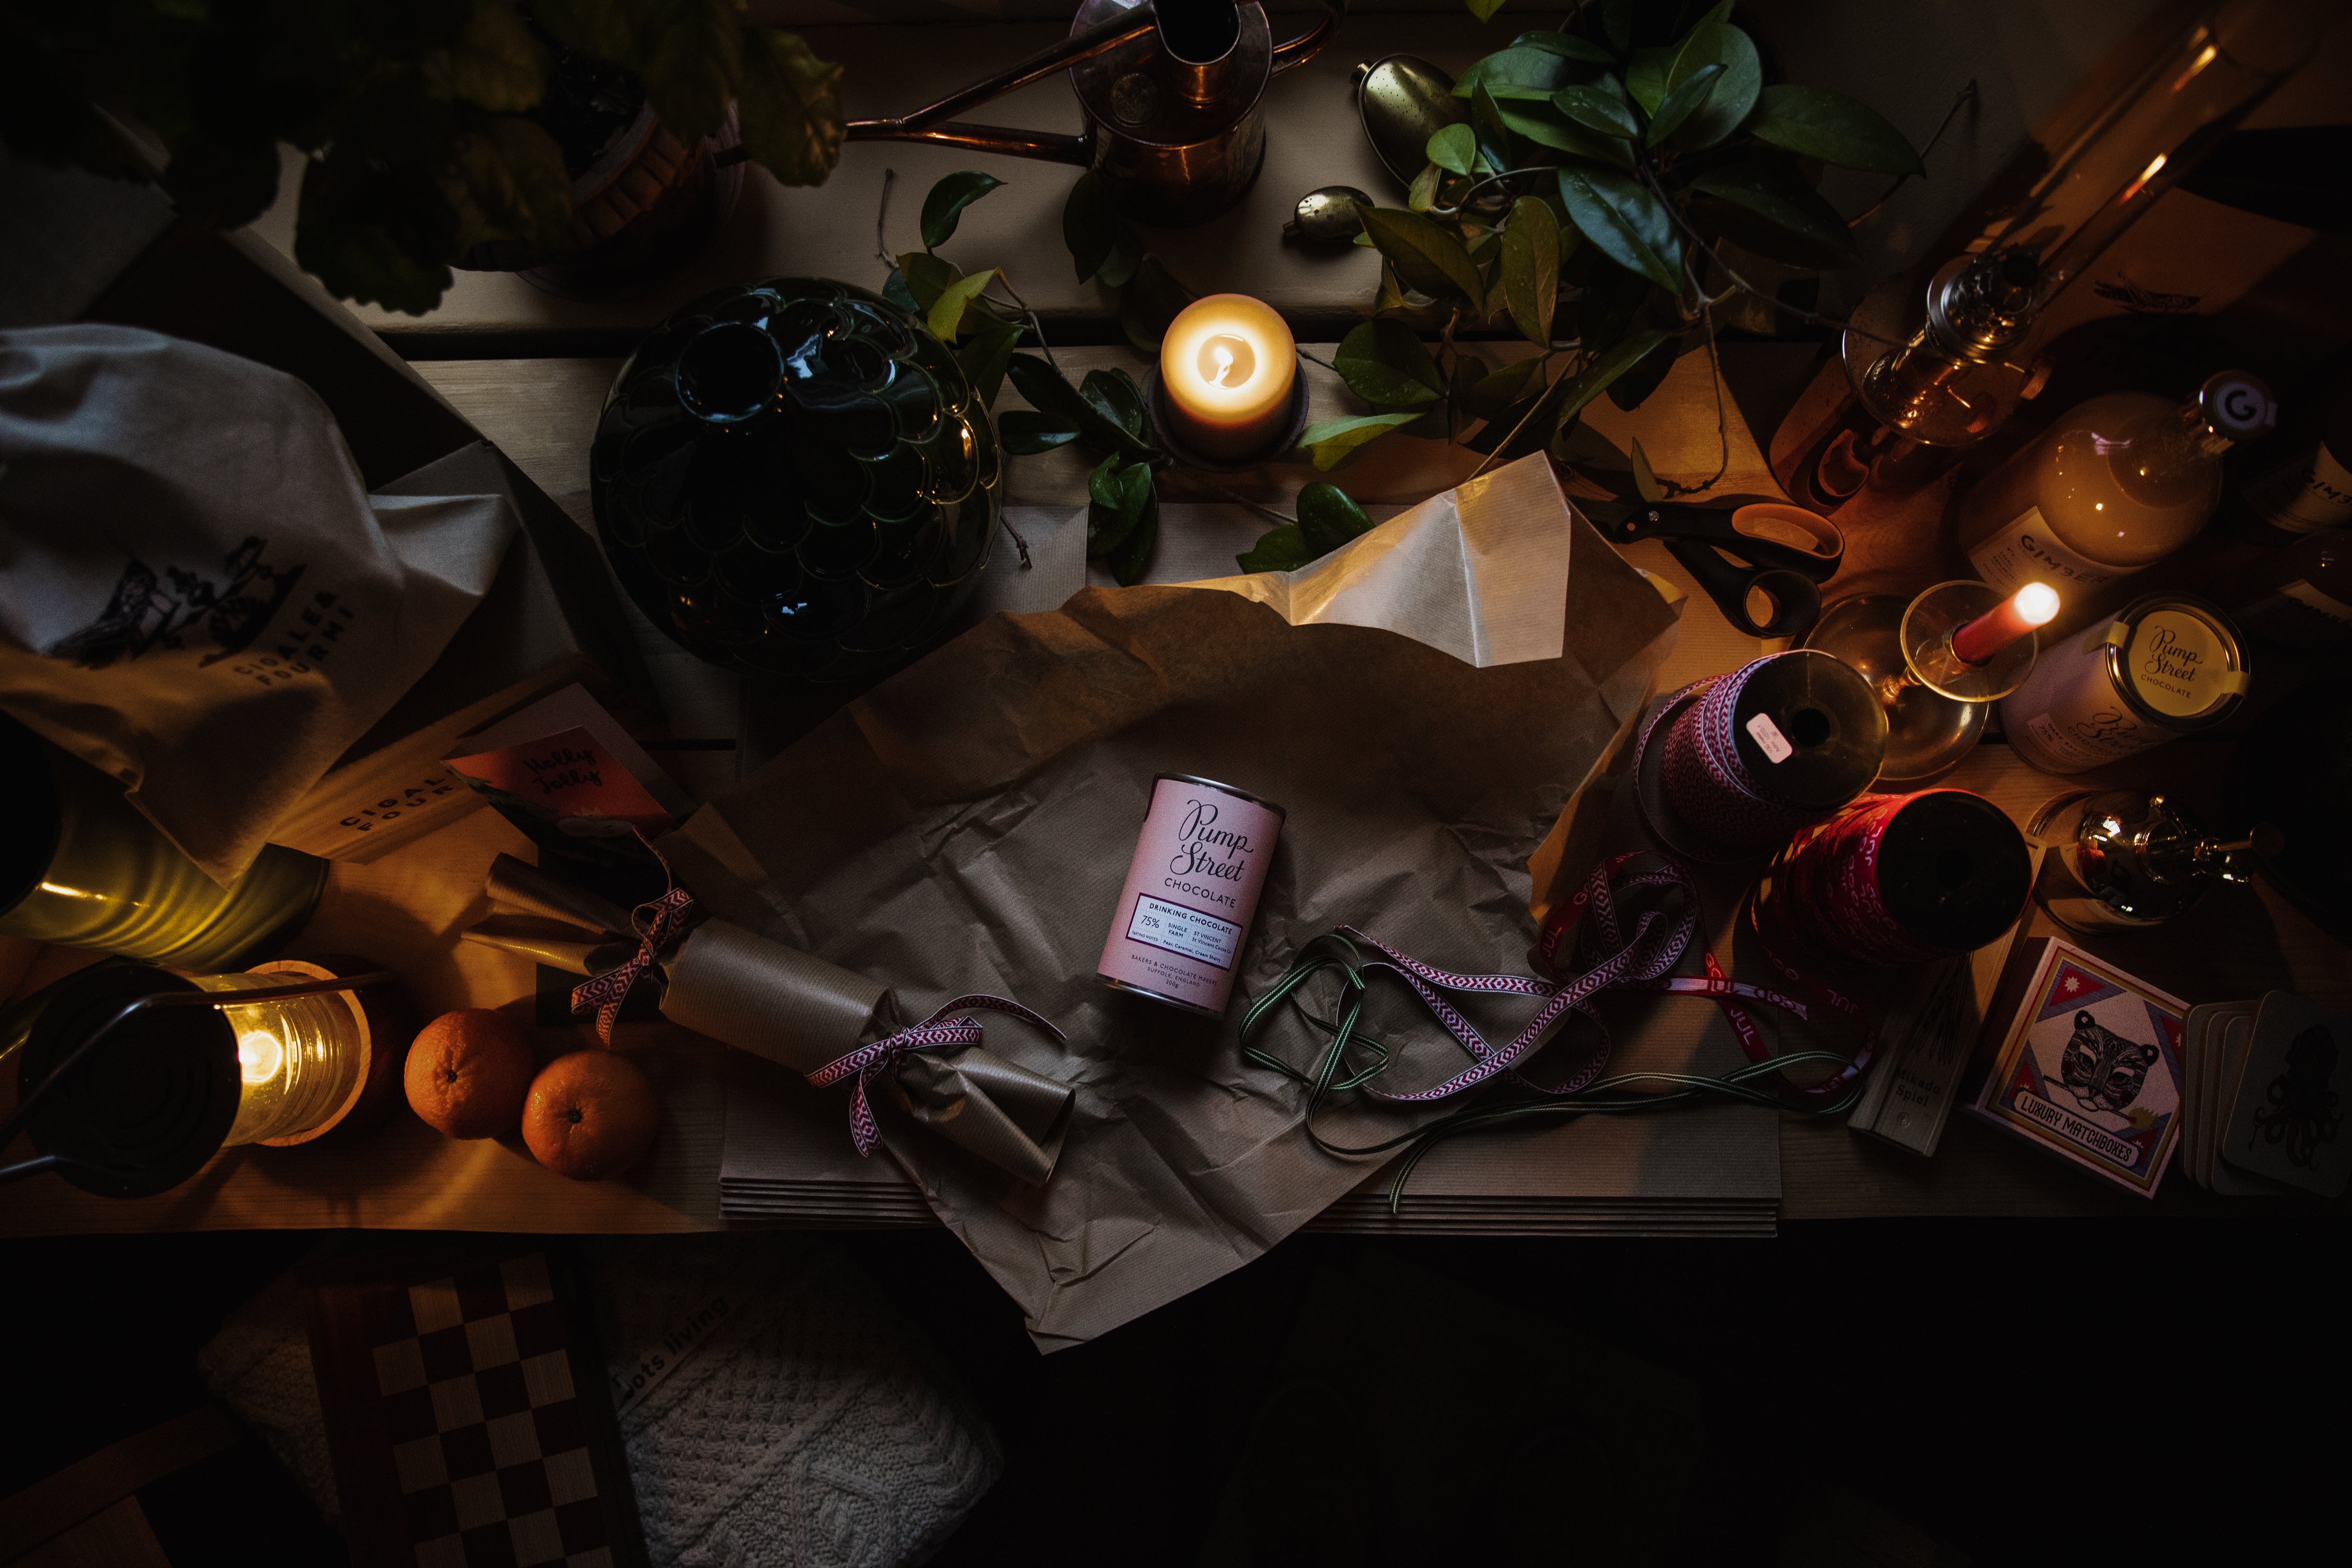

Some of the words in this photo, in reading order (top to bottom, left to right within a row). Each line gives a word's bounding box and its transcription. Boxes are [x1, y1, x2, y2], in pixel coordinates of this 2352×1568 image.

[2225, 390, 2257, 422] G
[256, 606, 354, 685] FOURMI
[2149, 625, 2203, 667] Pump
[2145, 653, 2196, 682] Street
[2140, 674, 2191, 699] CHOCOLATE
[523, 747, 596, 775] Holly
[532, 769, 603, 794] Jolly
[340, 769, 454, 826] CIGAL
[1179, 799, 1254, 859] Pump
[1864, 825, 1883, 867] JUL
[1170, 841, 1246, 882] Street
[1165, 878, 1237, 908] CHOCOLATE
[1140, 915, 1160, 929] 75%
[1149, 903, 1187, 919] DRINKING
[1189, 915, 1233, 935] CHOCOLATE
[1167, 923, 1188, 933] SINGLE
[1168, 929, 1184, 938] FARM
[1198, 939, 1215, 949] Vincent
[1201, 933, 1222, 944] VINCENT
[1542, 926, 1563, 959] JUL
[1131, 954, 1152, 965] BAKERS
[1160, 963, 1197, 979] CHOCOLATE
[1198, 975, 1217, 986] MAKERS
[1209, 954, 1221, 963] Sherry
[1166, 979, 1179, 989] 200g
[1174, 975, 1201, 988] ENGLAND
[1730, 1008, 1755, 1046] JUL
[1895, 1069, 1941, 1095] Mikado
[1895, 1083, 1929, 1107] Spiel
[2020, 1096, 2063, 1127] LUXURY
[2061, 1116, 2132, 1162] MATCHBOXES
[663, 1296, 730, 1355] living
